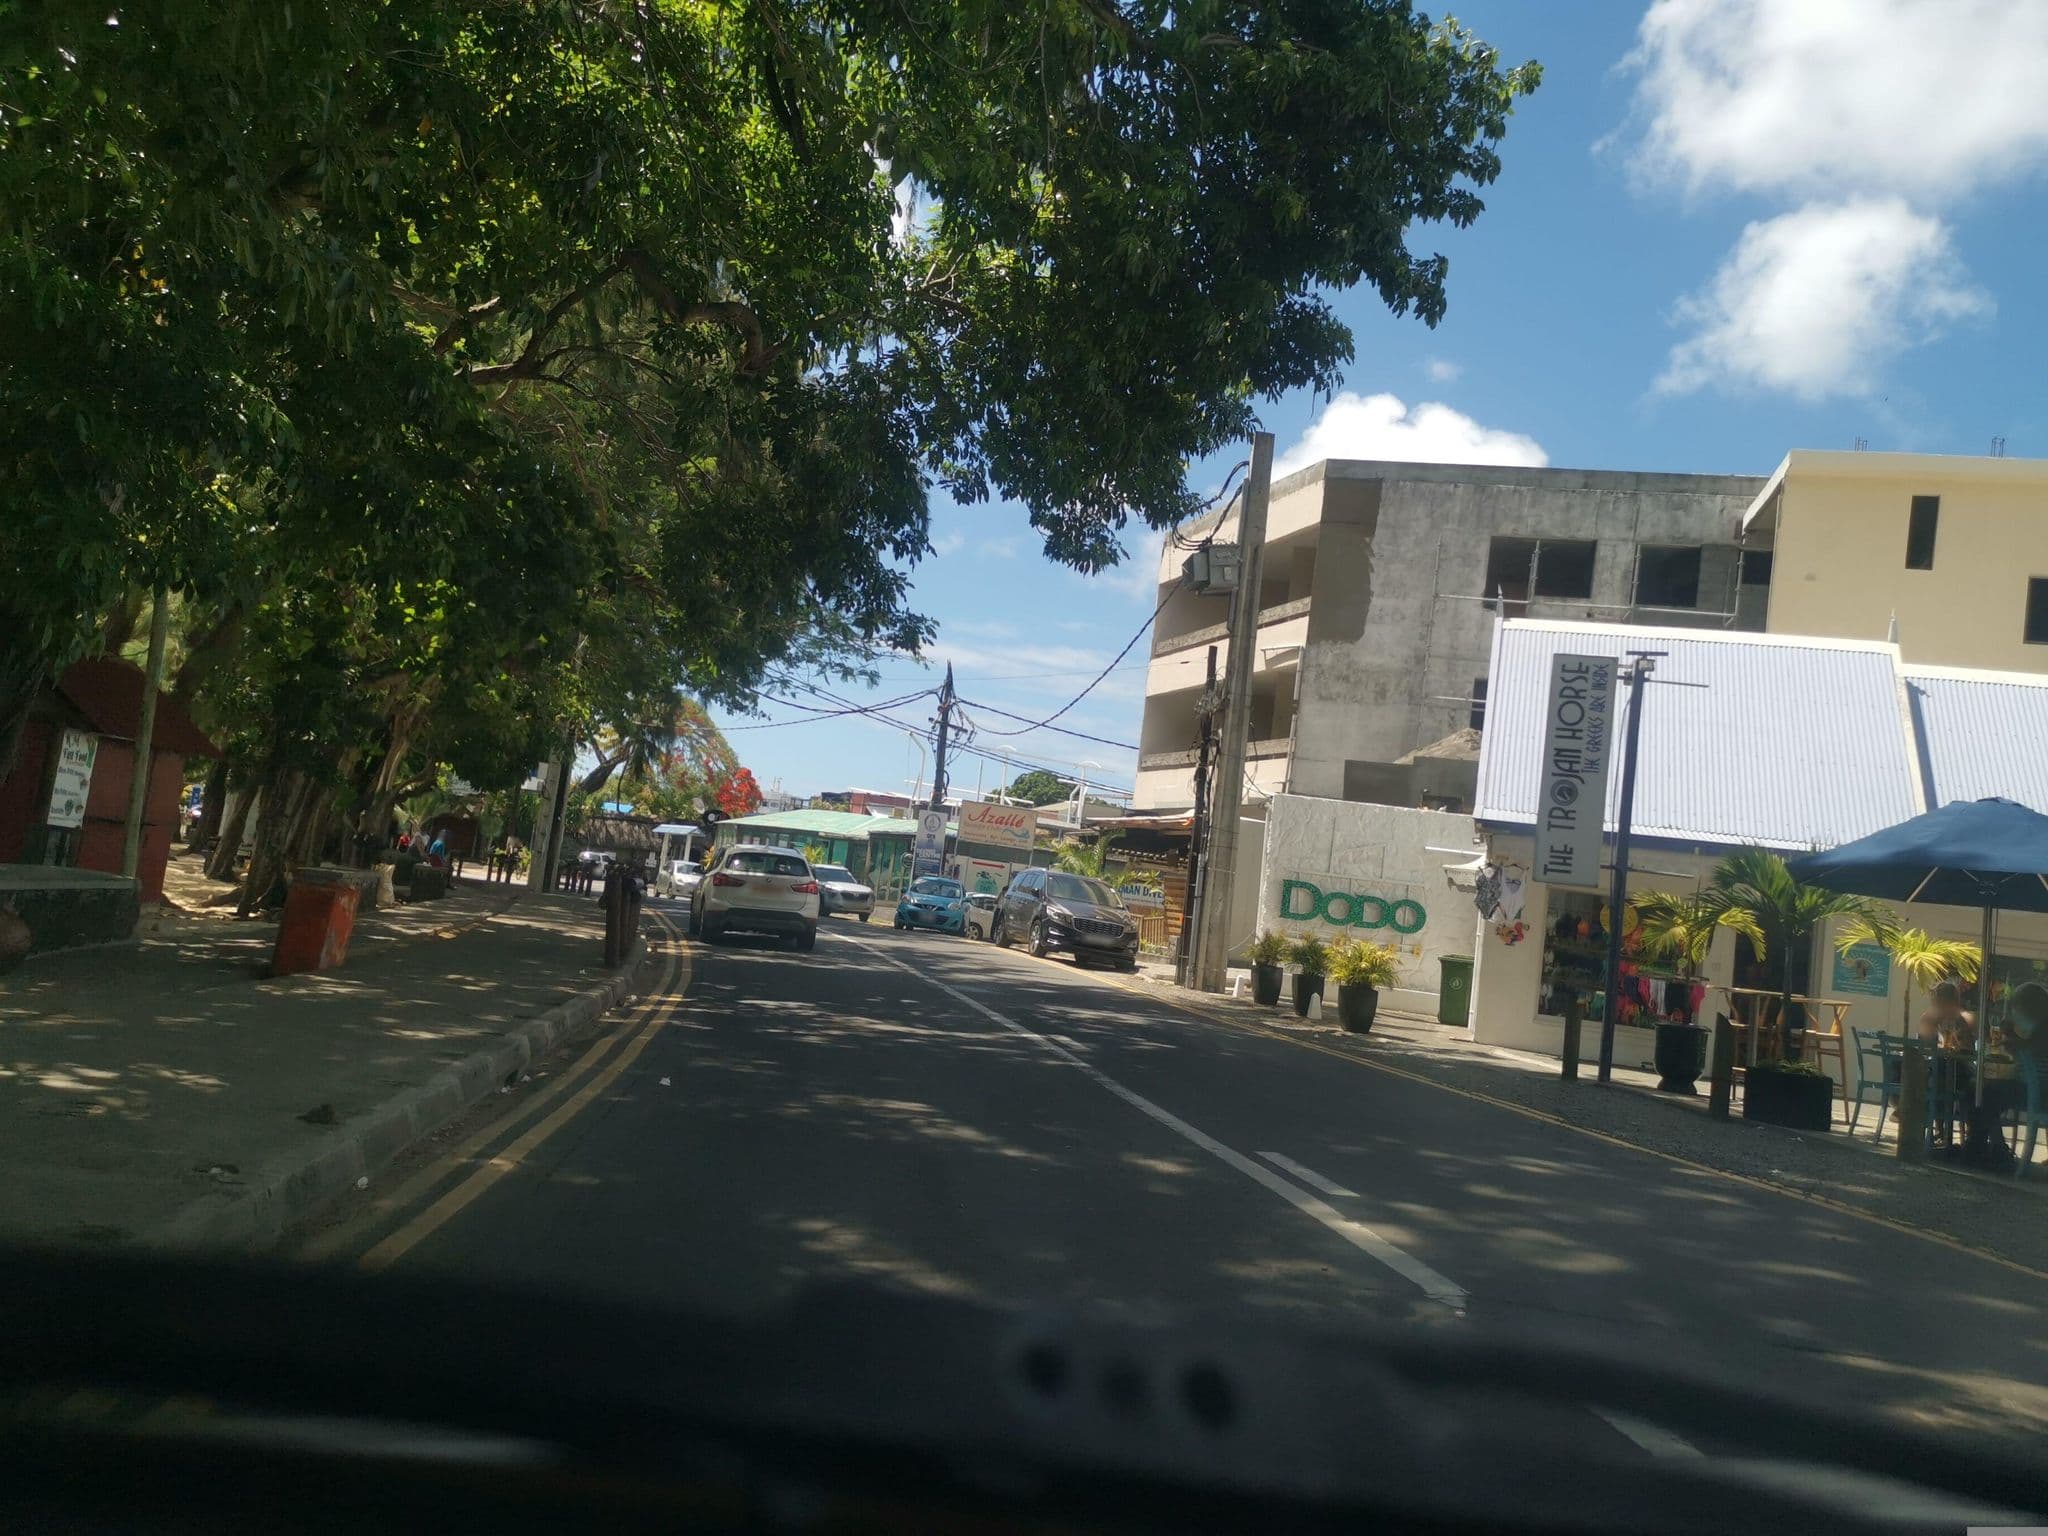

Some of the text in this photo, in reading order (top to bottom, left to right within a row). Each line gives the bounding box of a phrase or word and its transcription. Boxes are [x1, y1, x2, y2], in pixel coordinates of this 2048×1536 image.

[1589, 695, 1607, 712] ARE
[1585, 716, 1605, 752] GREEKS
[1543, 661, 1590, 876] THE TROJAN HORSE
[1279, 879, 1427, 934] DODO
